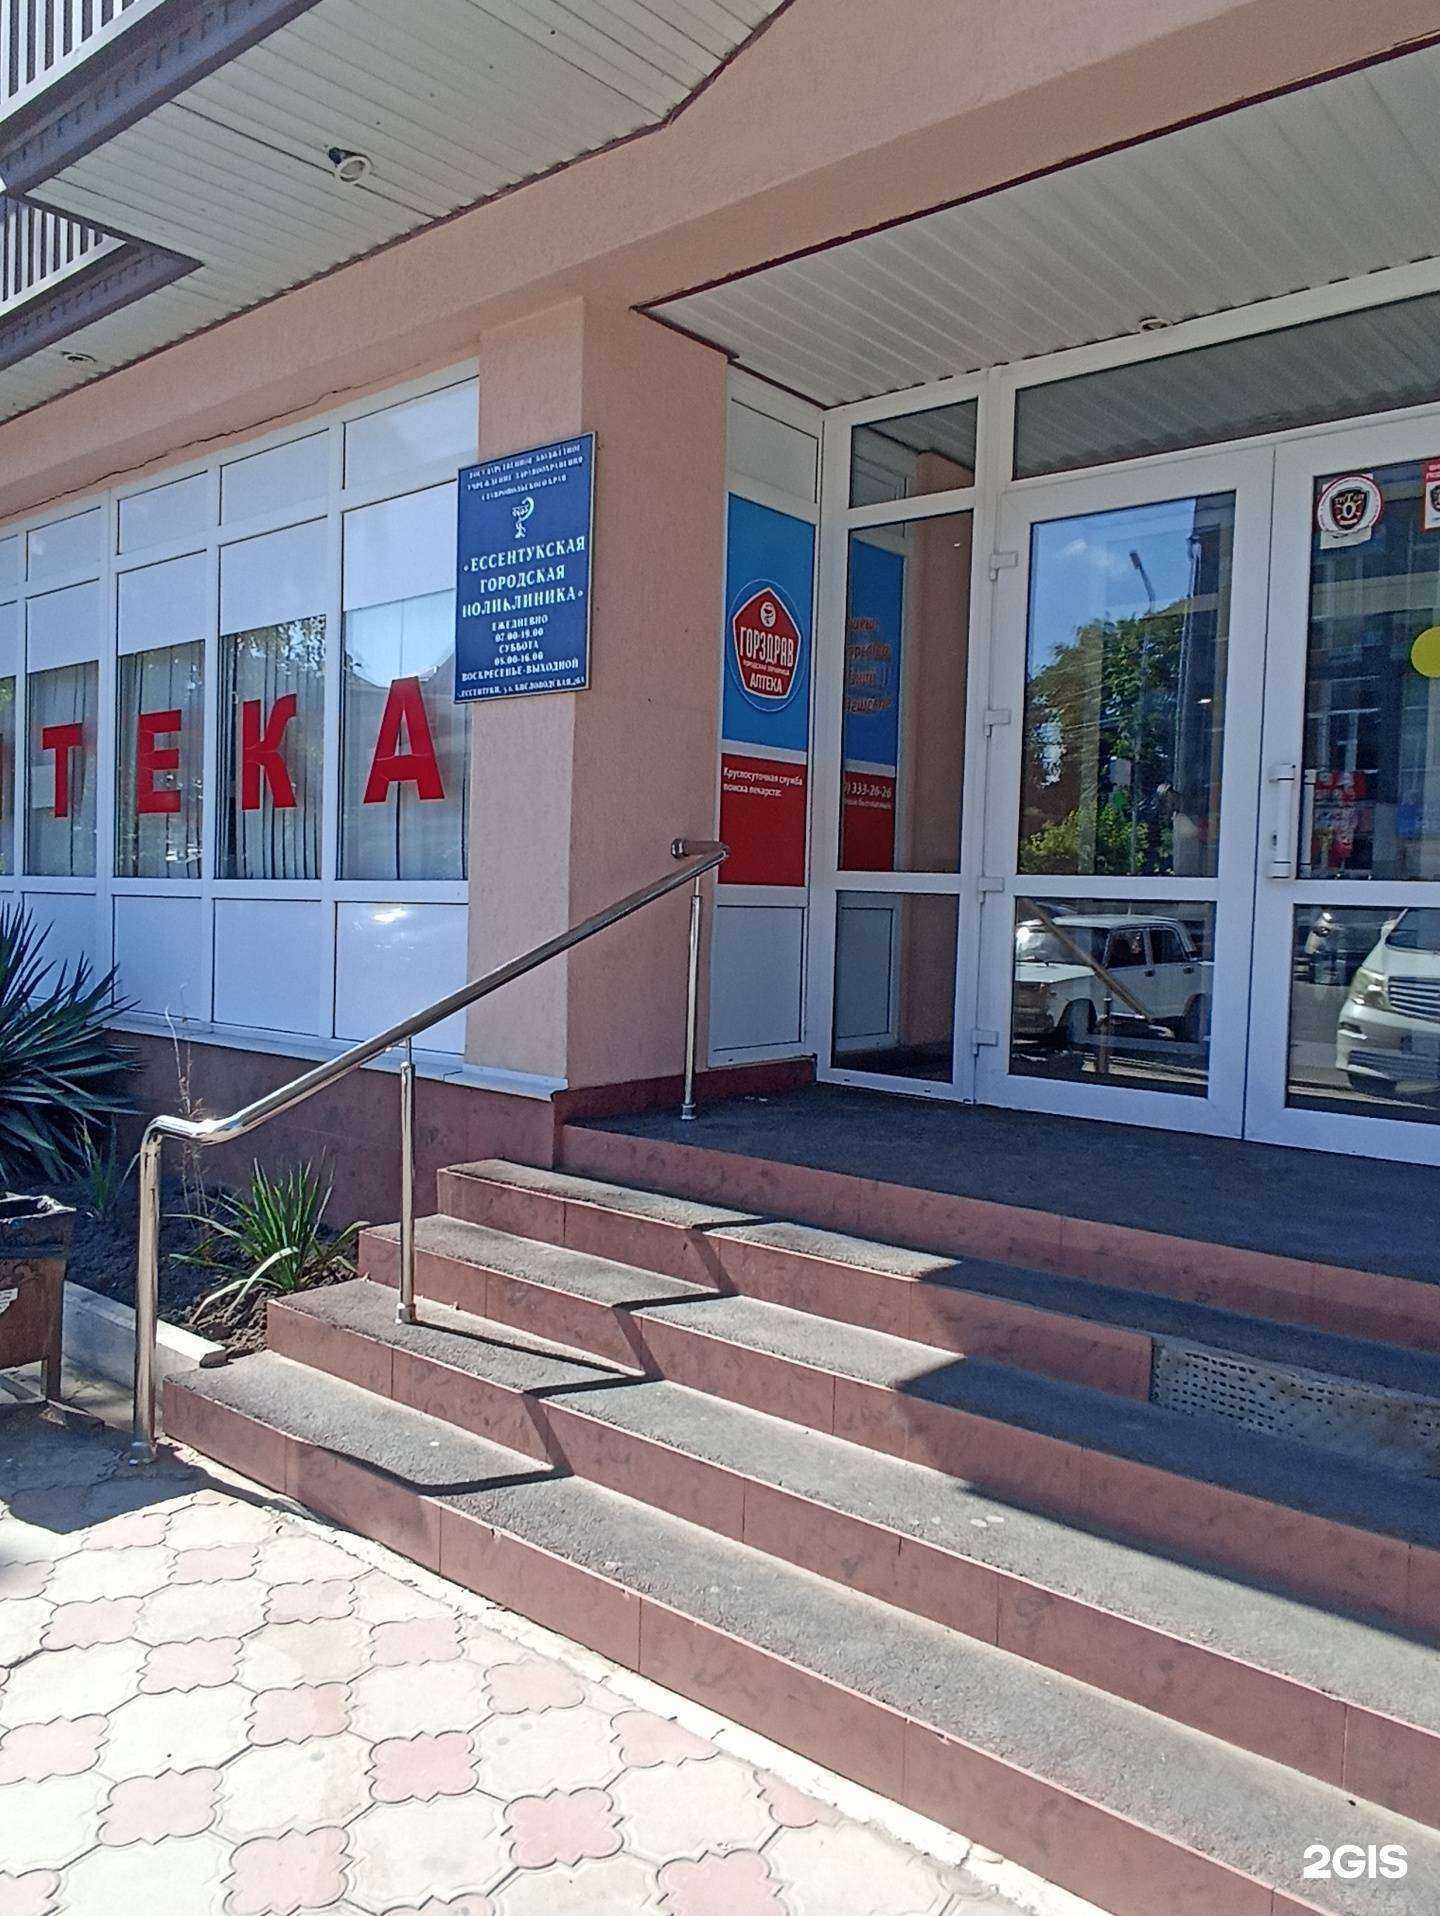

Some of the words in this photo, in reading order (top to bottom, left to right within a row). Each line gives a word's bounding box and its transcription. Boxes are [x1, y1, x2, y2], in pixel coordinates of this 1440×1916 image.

[480, 564, 566, 594] ГОРОДСКАЯ
[491, 614, 549, 632] ЕЖЕДНЕВНО
[498, 641, 539, 654] СУББОТА
[739, 626, 795, 668] ГОРЗДРАВ
[749, 672, 784, 694] АПТЕКА
[0, 676, 446, 819] ТЕКА
[723, 766, 778, 783] Круглосуточная
